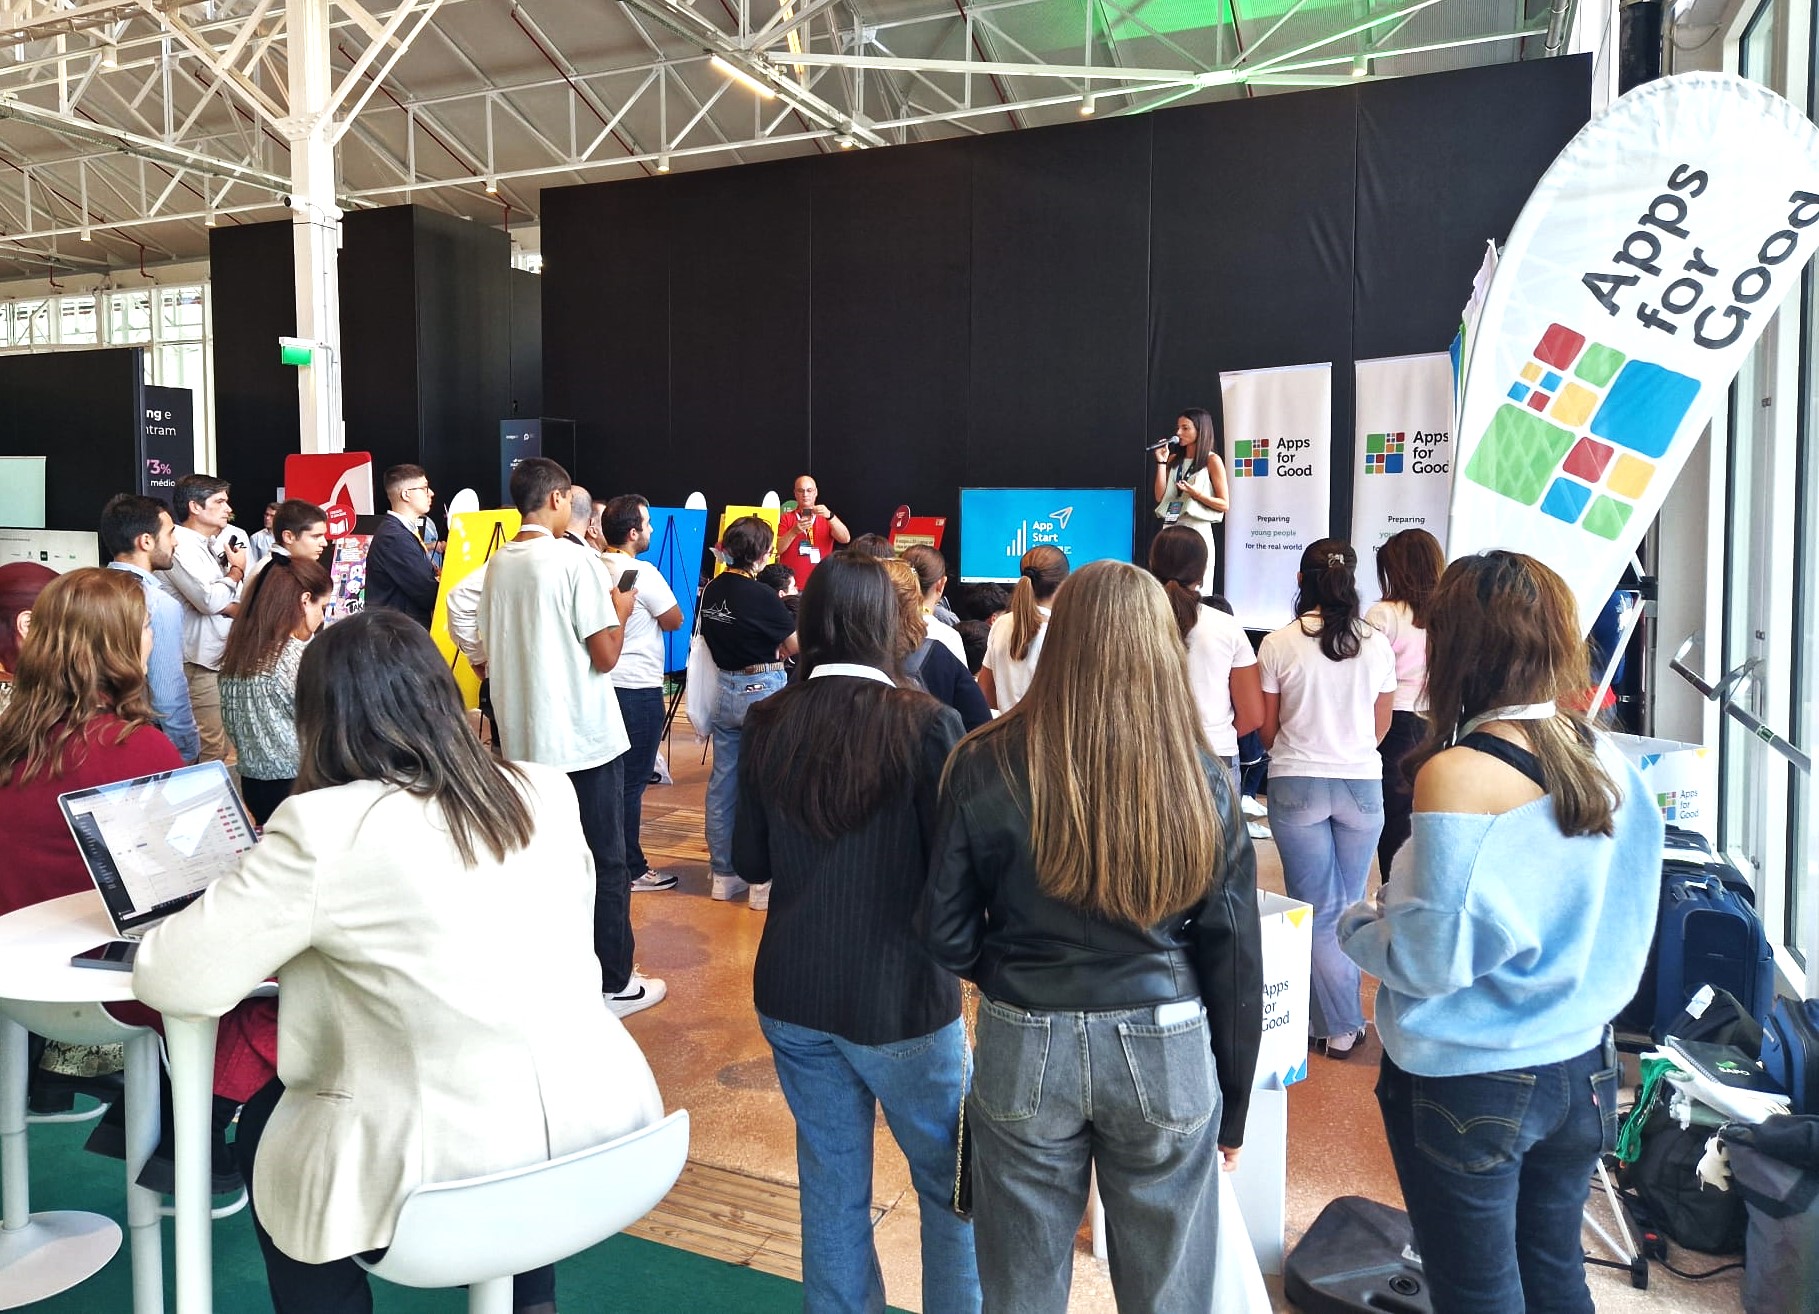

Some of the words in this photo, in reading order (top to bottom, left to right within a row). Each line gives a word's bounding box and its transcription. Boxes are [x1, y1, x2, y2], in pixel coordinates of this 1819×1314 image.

[1581, 163, 1709, 317] Apps
[1693, 190, 1819, 350] Good
[1636, 246, 1719, 336] for
[164, 411, 172, 420] e
[1411, 430, 1449, 446] Apps
[1276, 437, 1311, 451] Apps
[1277, 452, 1296, 463] for
[1412, 446, 1434, 459] for
[1276, 464, 1313, 477] Good
[1257, 515, 1291, 524] Preparing
[1387, 515, 1426, 525] Preparing
[1032, 520, 1053, 532] App
[1032, 532, 1059, 543] Start
[1250, 529, 1272, 538] young
[1273, 529, 1297, 538] people
[1256, 542, 1267, 550] the
[1282, 543, 1303, 551] world
[1680, 789, 1698, 800] Apps
[1680, 800, 1690, 809] for
[1680, 809, 1699, 820] Good
[1263, 1001, 1277, 1014] or
